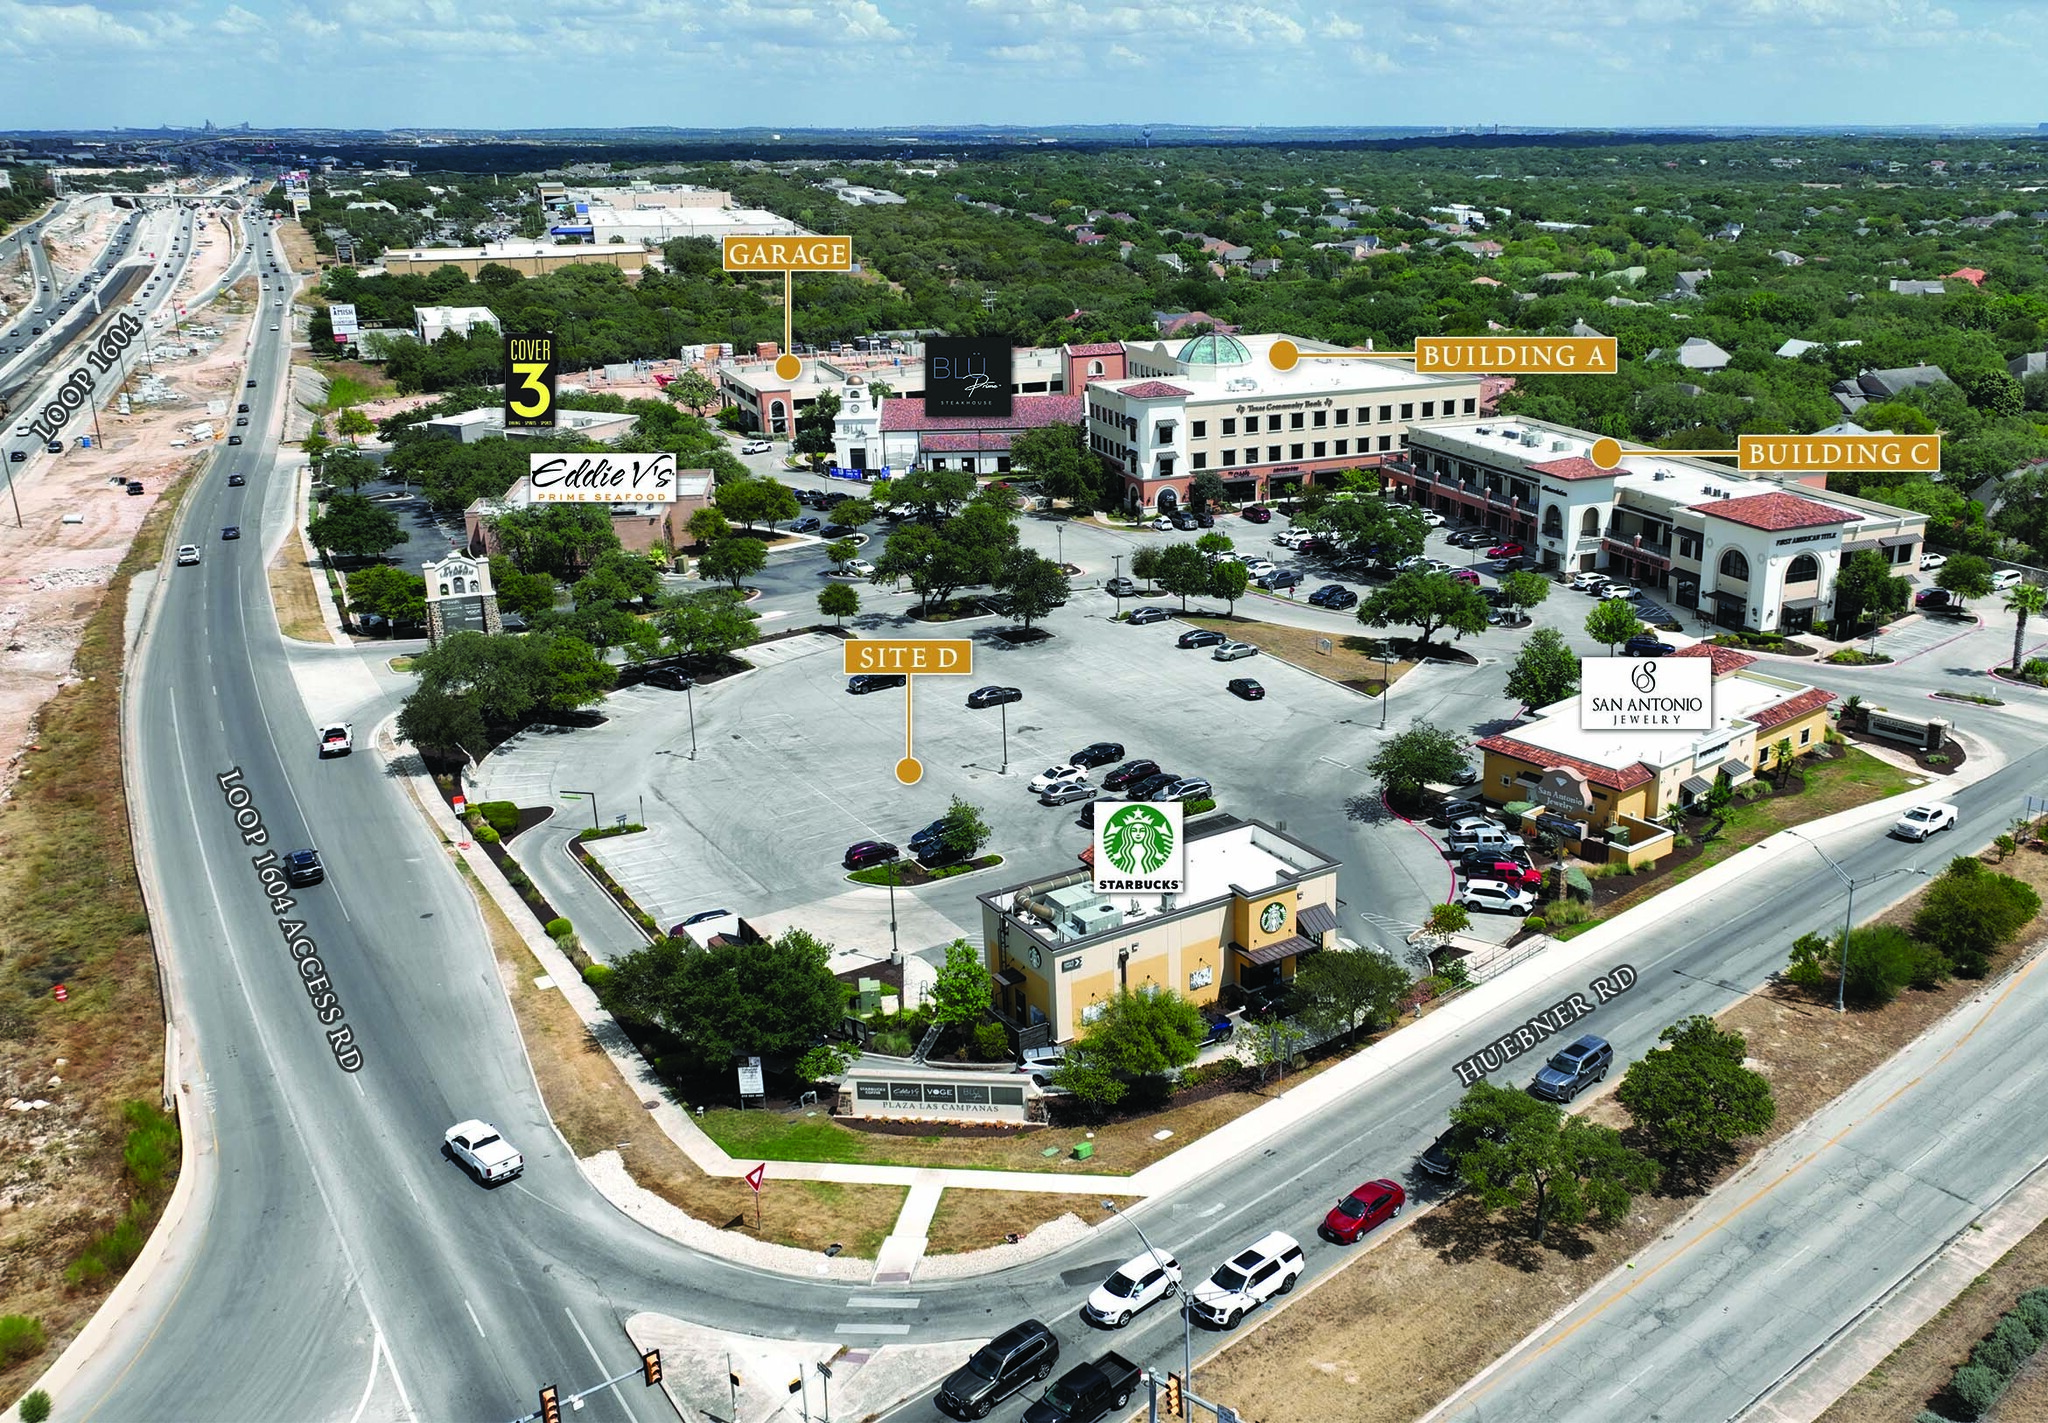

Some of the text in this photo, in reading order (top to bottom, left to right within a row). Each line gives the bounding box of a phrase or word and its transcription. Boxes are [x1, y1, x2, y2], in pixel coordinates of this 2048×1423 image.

[1792, 534, 1820, 544] AMERICAN
[1538, 786, 1583, 806] San Antonio
[1545, 797, 1573, 812] Jewelry
[882, 1101, 1000, 1113] PLAZA LAS CAMPANAS
